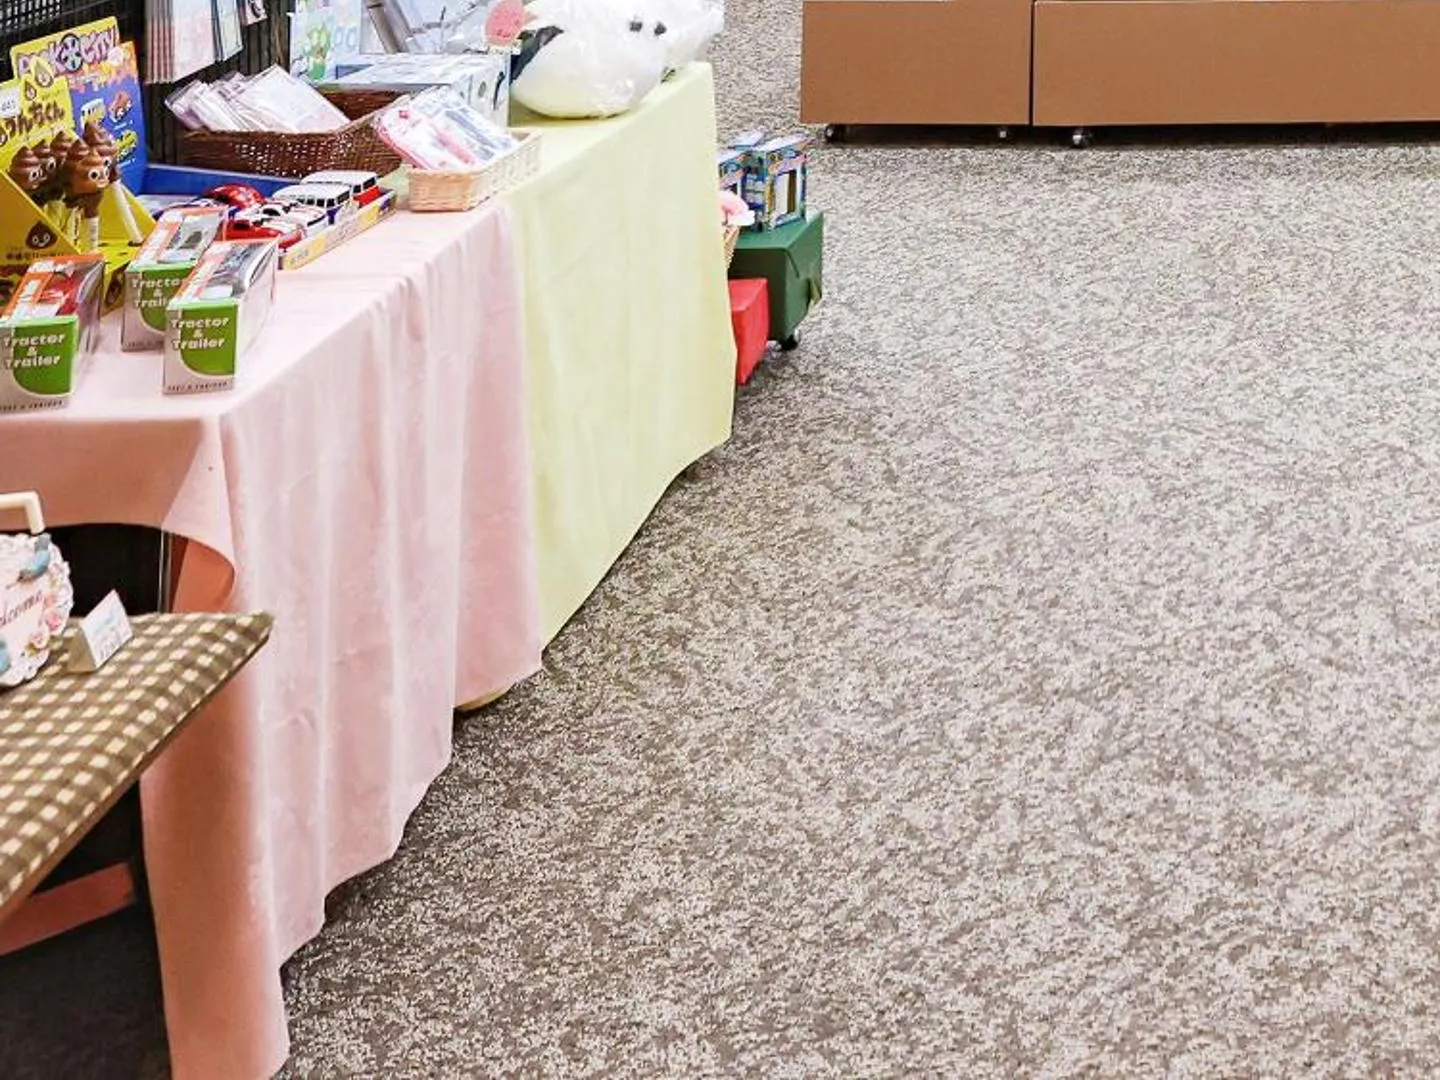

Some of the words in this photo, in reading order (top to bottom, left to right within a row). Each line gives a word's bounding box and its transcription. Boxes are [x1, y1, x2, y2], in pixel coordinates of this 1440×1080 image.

[132, 278, 182, 288] Tracto
[170, 317, 230, 329] Tractor
[193, 328, 204, 338] &
[3, 333, 66, 347] Tractor
[172, 338, 225, 350] Trailer
[27, 346, 38, 357] &
[6, 355, 61, 369] Trailer
